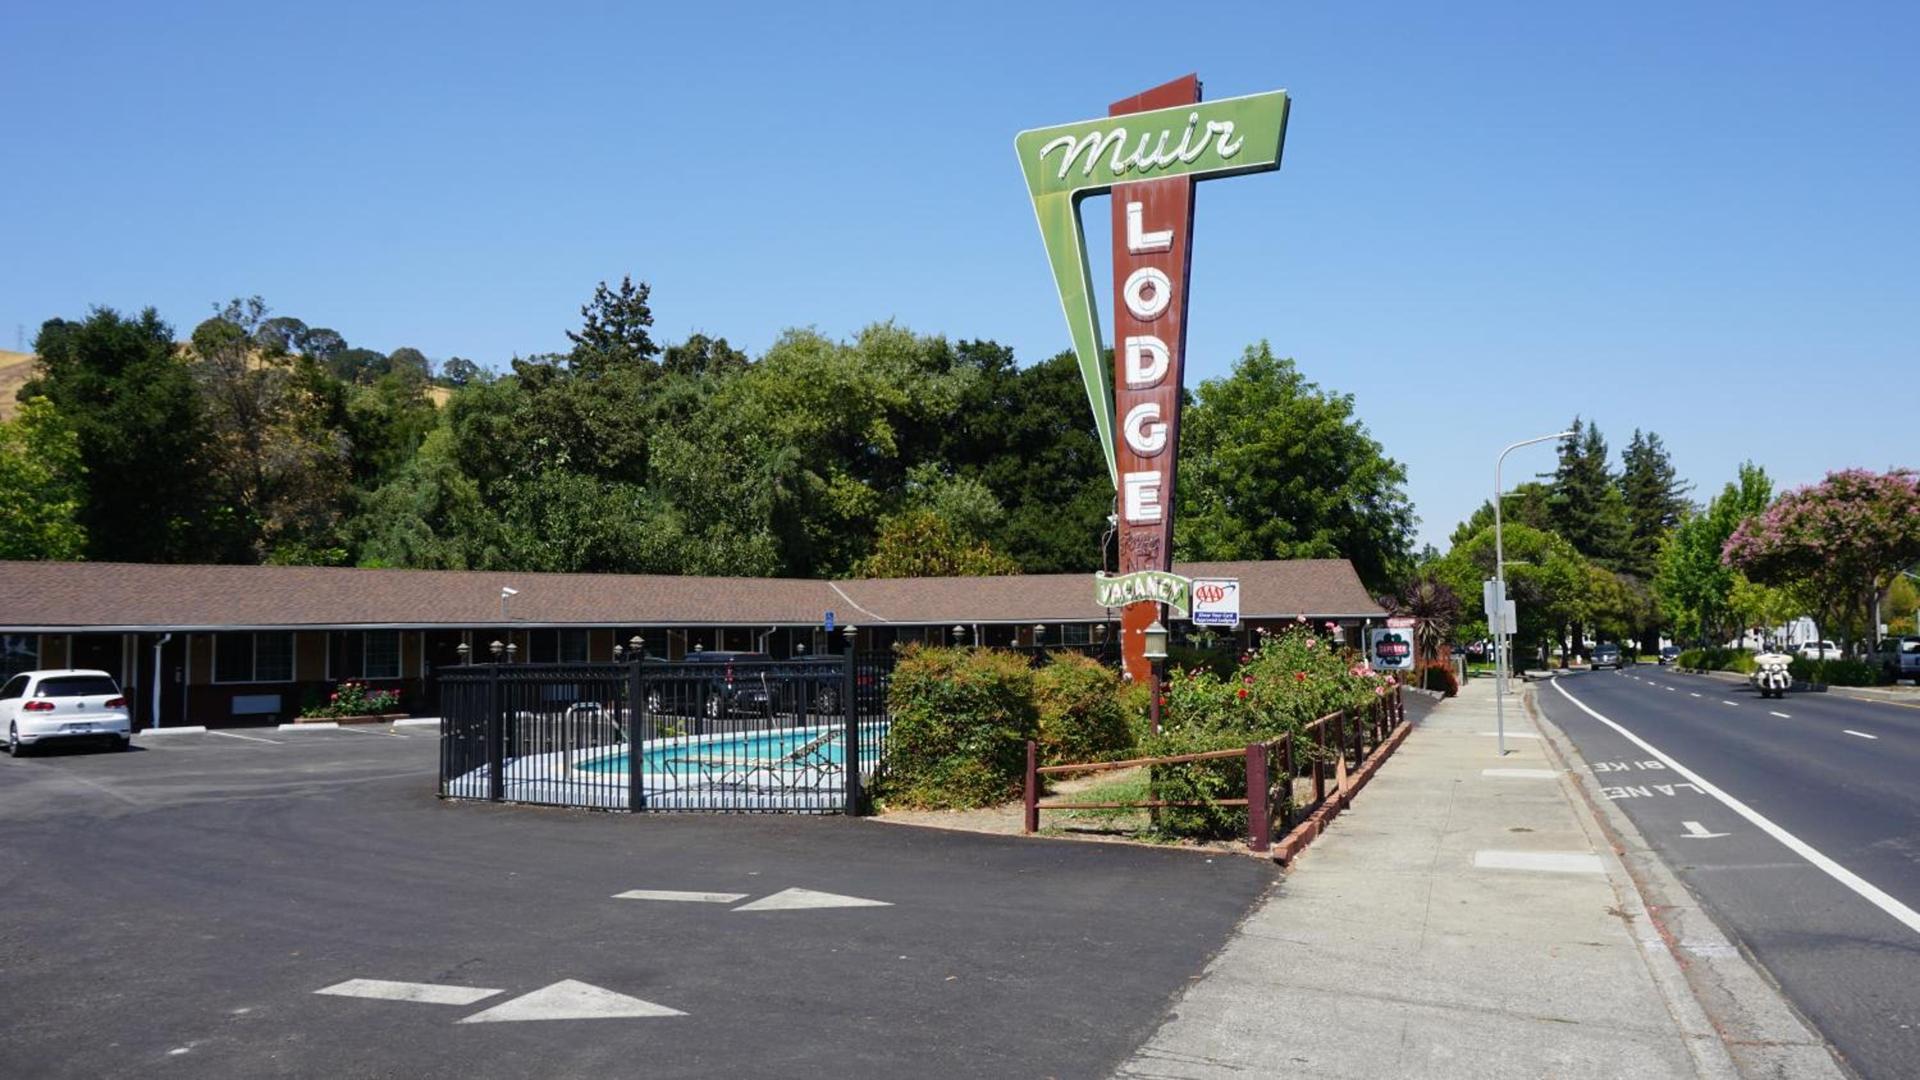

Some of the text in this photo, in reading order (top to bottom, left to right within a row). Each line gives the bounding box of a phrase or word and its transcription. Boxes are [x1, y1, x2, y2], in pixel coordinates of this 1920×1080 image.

[1123, 202, 1174, 525] LODGE
[1100, 575, 1184, 605] VACANCY
[1196, 585, 1224, 603] AAA
[1593, 760, 1666, 772] BIKE
[1600, 783, 1706, 800] LANE
